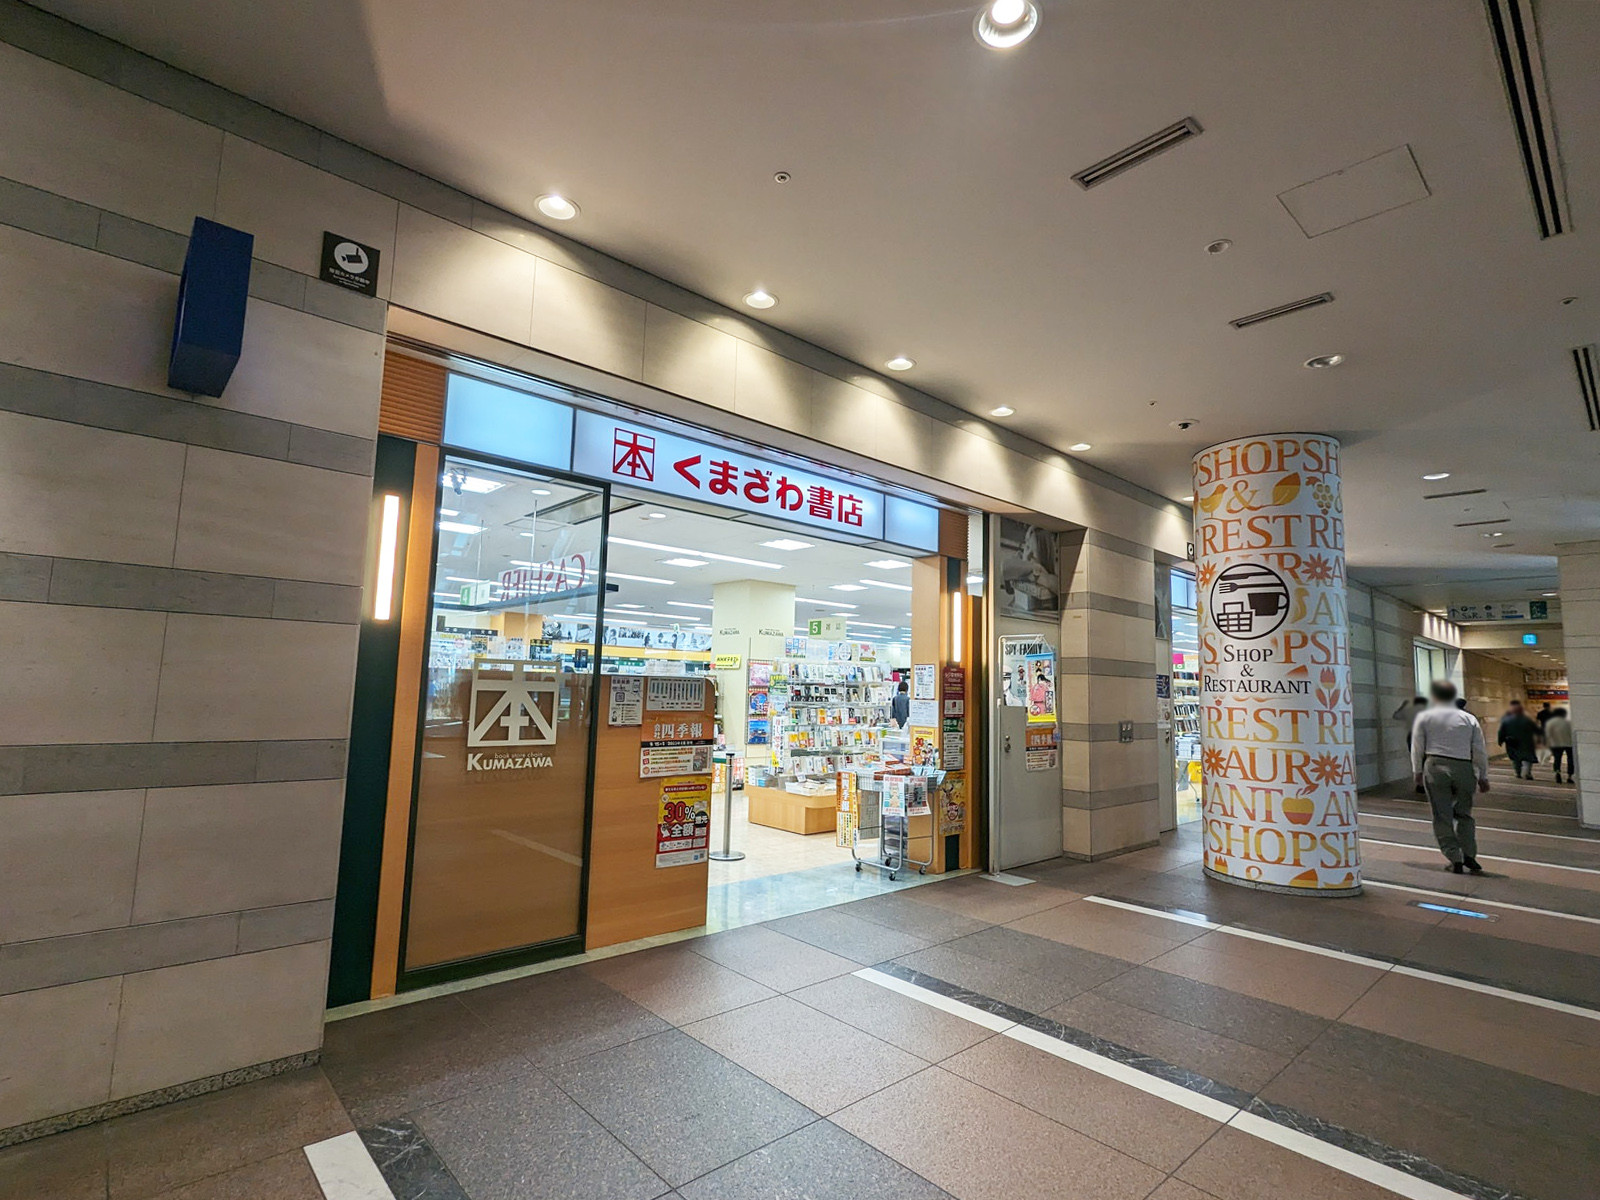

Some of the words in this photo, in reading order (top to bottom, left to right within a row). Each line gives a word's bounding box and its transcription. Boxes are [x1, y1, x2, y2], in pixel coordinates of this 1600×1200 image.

[673, 455, 863, 527] くまざわ書店
[812, 622, 818, 634] 5
[1224, 644, 1273, 662] SHOP
[1240, 664, 1255, 677] &
[1204, 675, 1312, 694] RESTAURANT
[467, 753, 554, 771] KUMAZAWA
